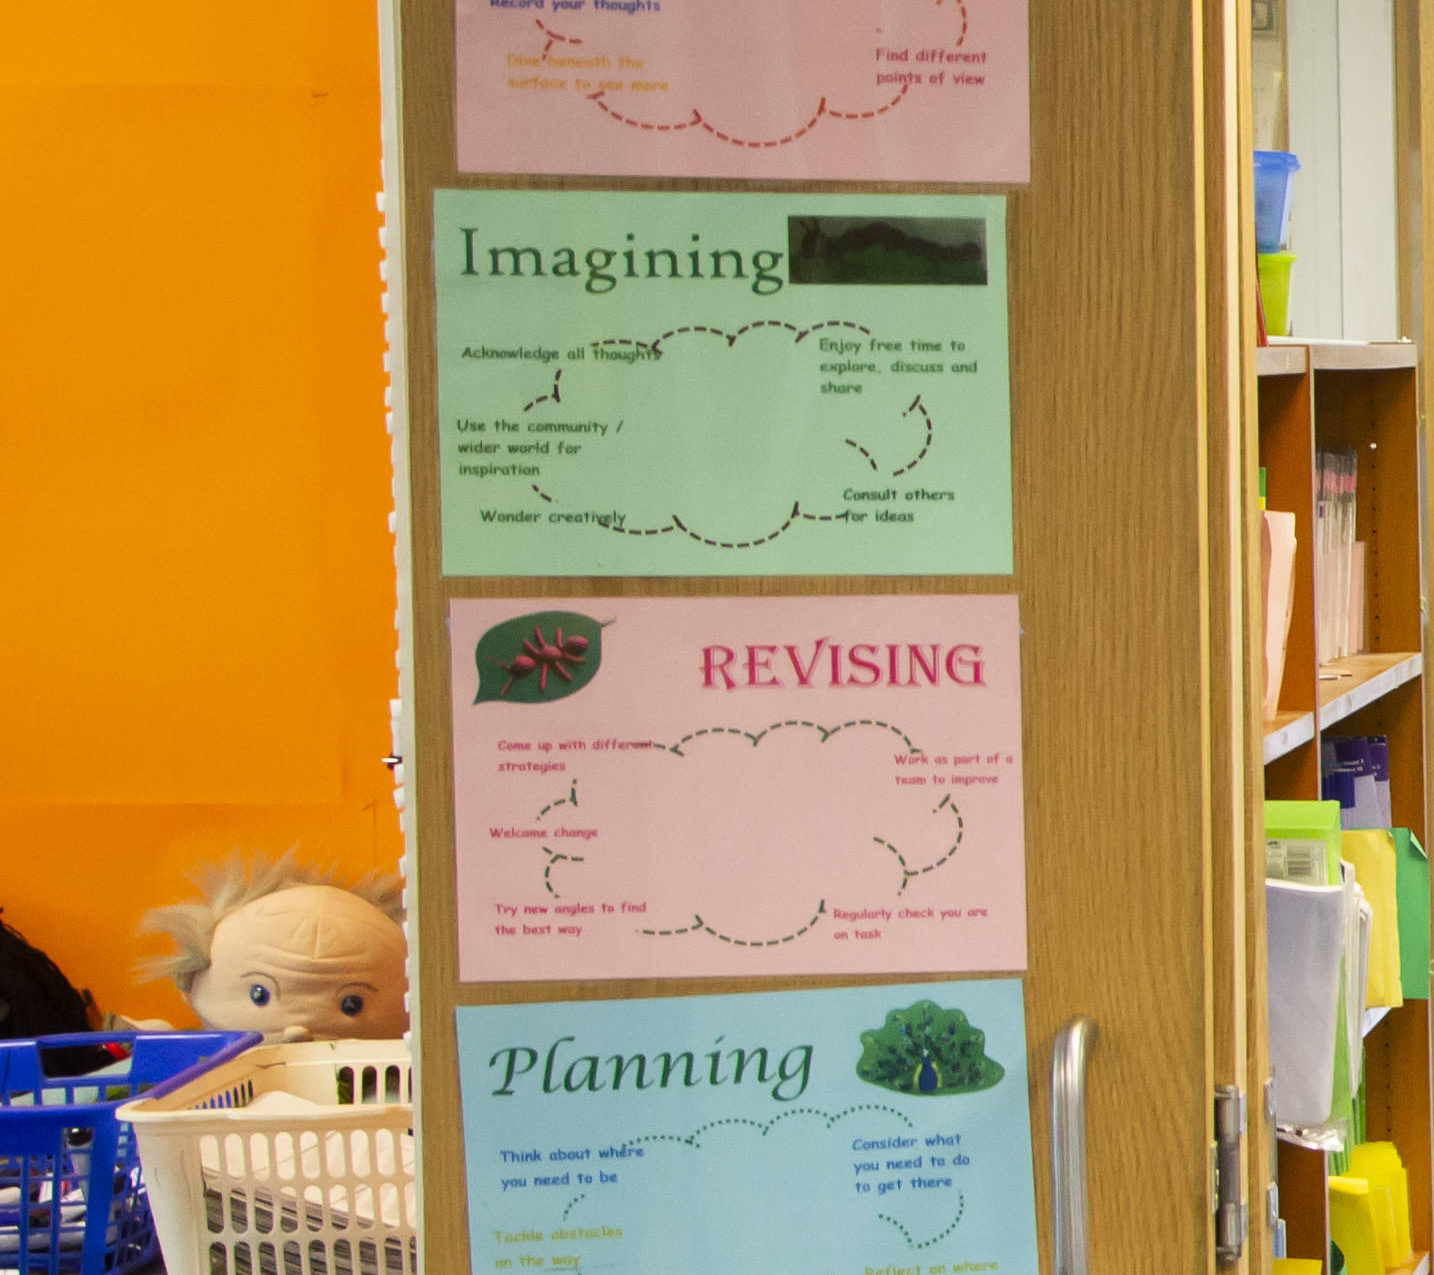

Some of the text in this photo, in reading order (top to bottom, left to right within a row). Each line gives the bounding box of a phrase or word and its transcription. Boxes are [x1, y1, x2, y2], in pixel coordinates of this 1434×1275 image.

[460, 227, 784, 296] Imagining
[819, 338, 965, 354] Enjoy free time to
[462, 347, 558, 362] Acknowledge
[568, 348, 584, 361] all
[892, 360, 944, 374] discuss
[952, 360, 978, 374] and
[820, 382, 862, 394] share
[457, 420, 486, 434] Use
[494, 420, 520, 433] the
[528, 421, 608, 436] community
[458, 441, 582, 455] wider world for
[459, 464, 540, 478] inspiration
[843, 488, 955, 502] Consult others
[480, 510, 626, 526] Wonder creatively
[844, 509, 914, 524] for ideas
[700, 636, 988, 691] REVISING
[488, 1035, 814, 1102] Planning
[852, 1134, 962, 1152] Consider what
[500, 1145, 644, 1164] Think about where
[854, 1154, 970, 1174] you need to do
[502, 1170, 618, 1190] you need to be
[856, 1175, 952, 1194] to get there
